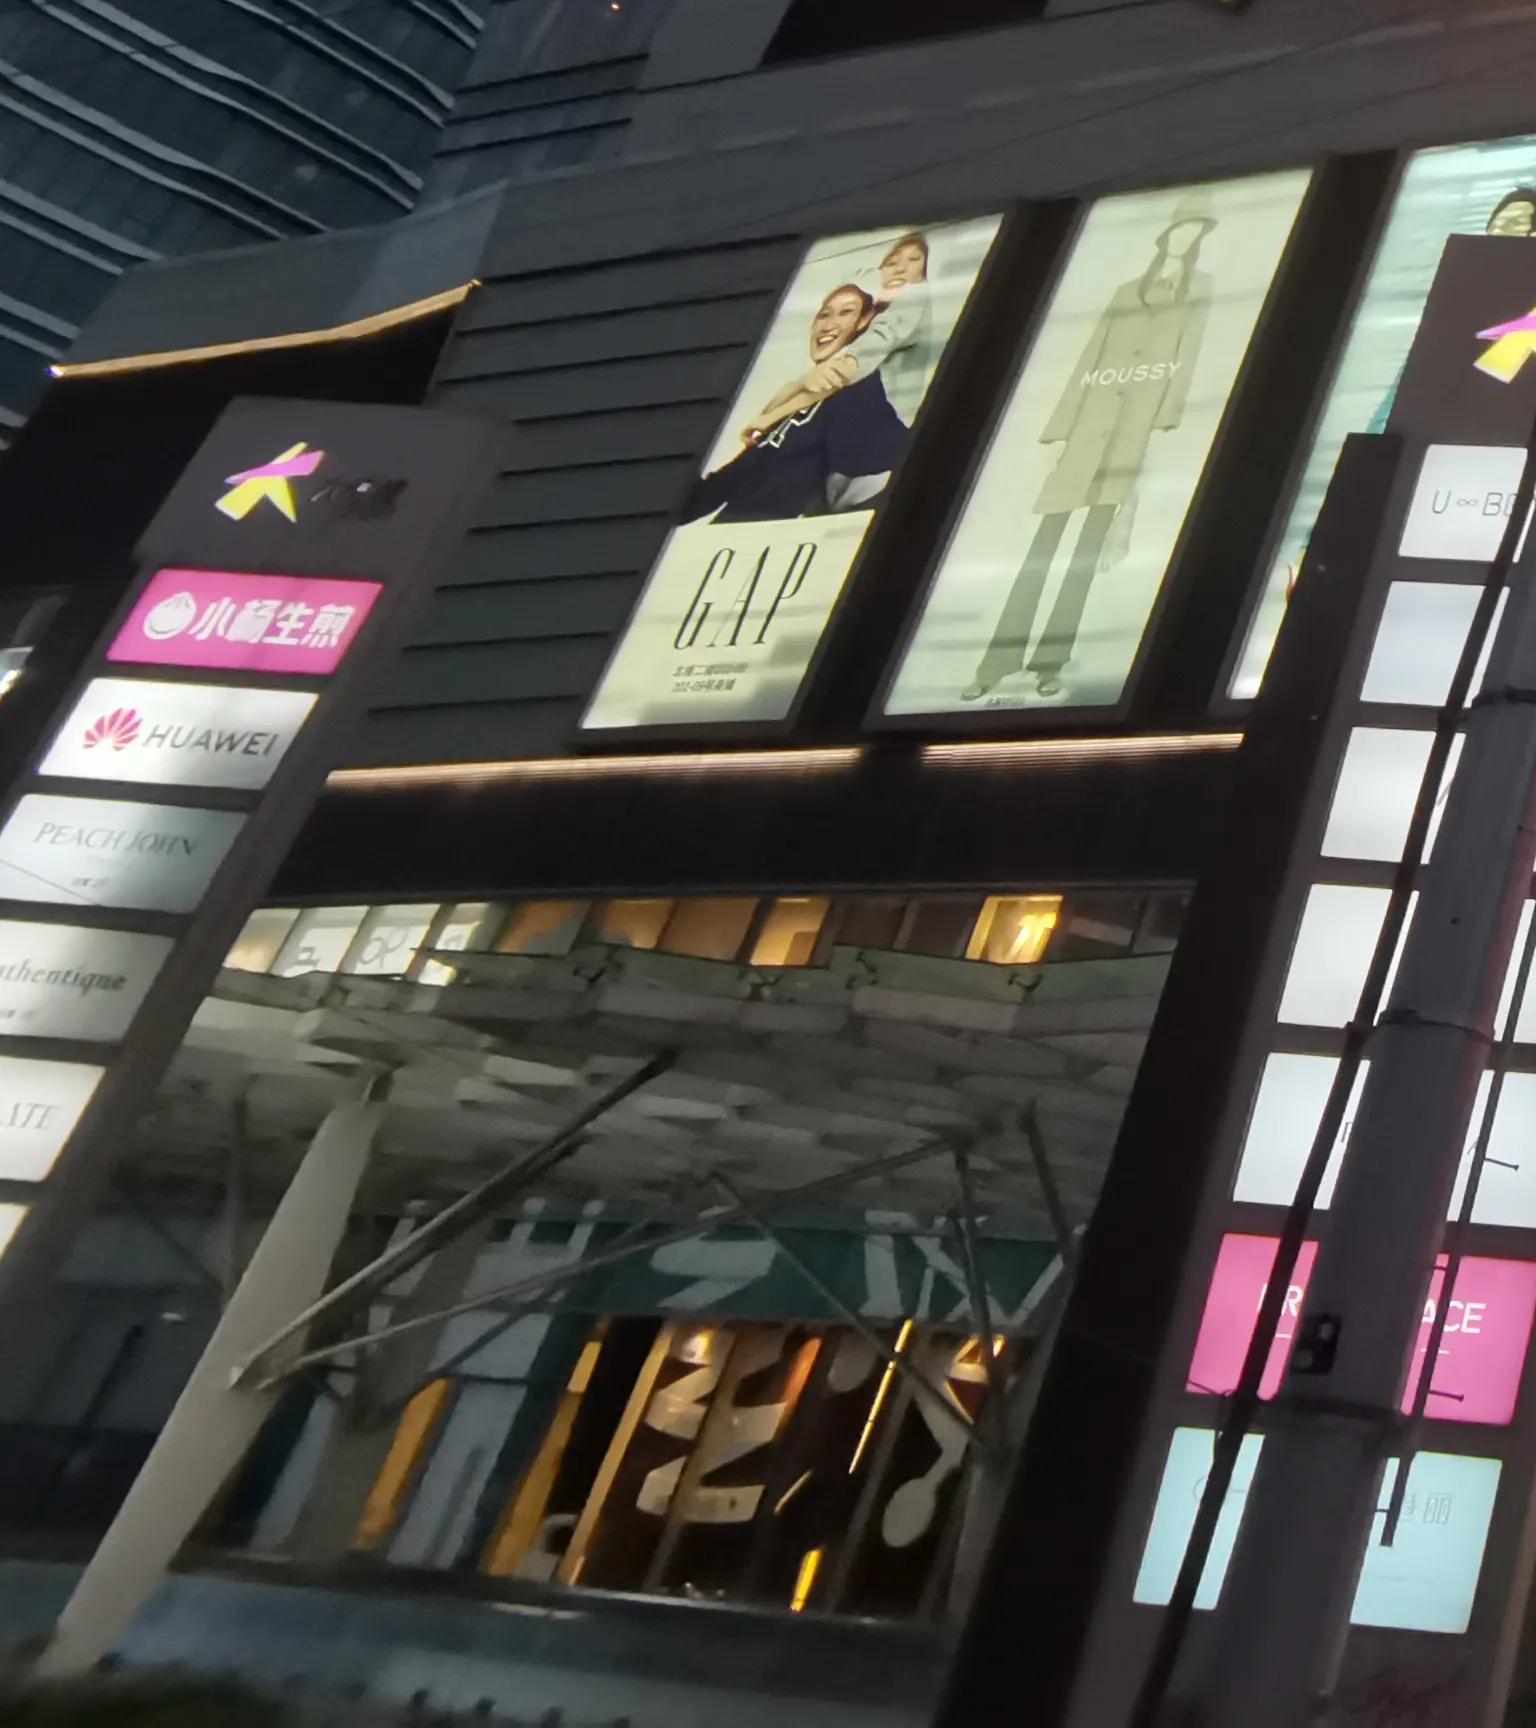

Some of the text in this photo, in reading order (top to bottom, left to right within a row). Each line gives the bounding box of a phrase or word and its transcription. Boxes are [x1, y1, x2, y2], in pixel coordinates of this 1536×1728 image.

[1081, 361, 1181, 387] MOUSSY
[673, 542, 818, 651] GAP
[142, 724, 280, 756] HUAWEI
[34, 822, 199, 856] PEACH JOHN
